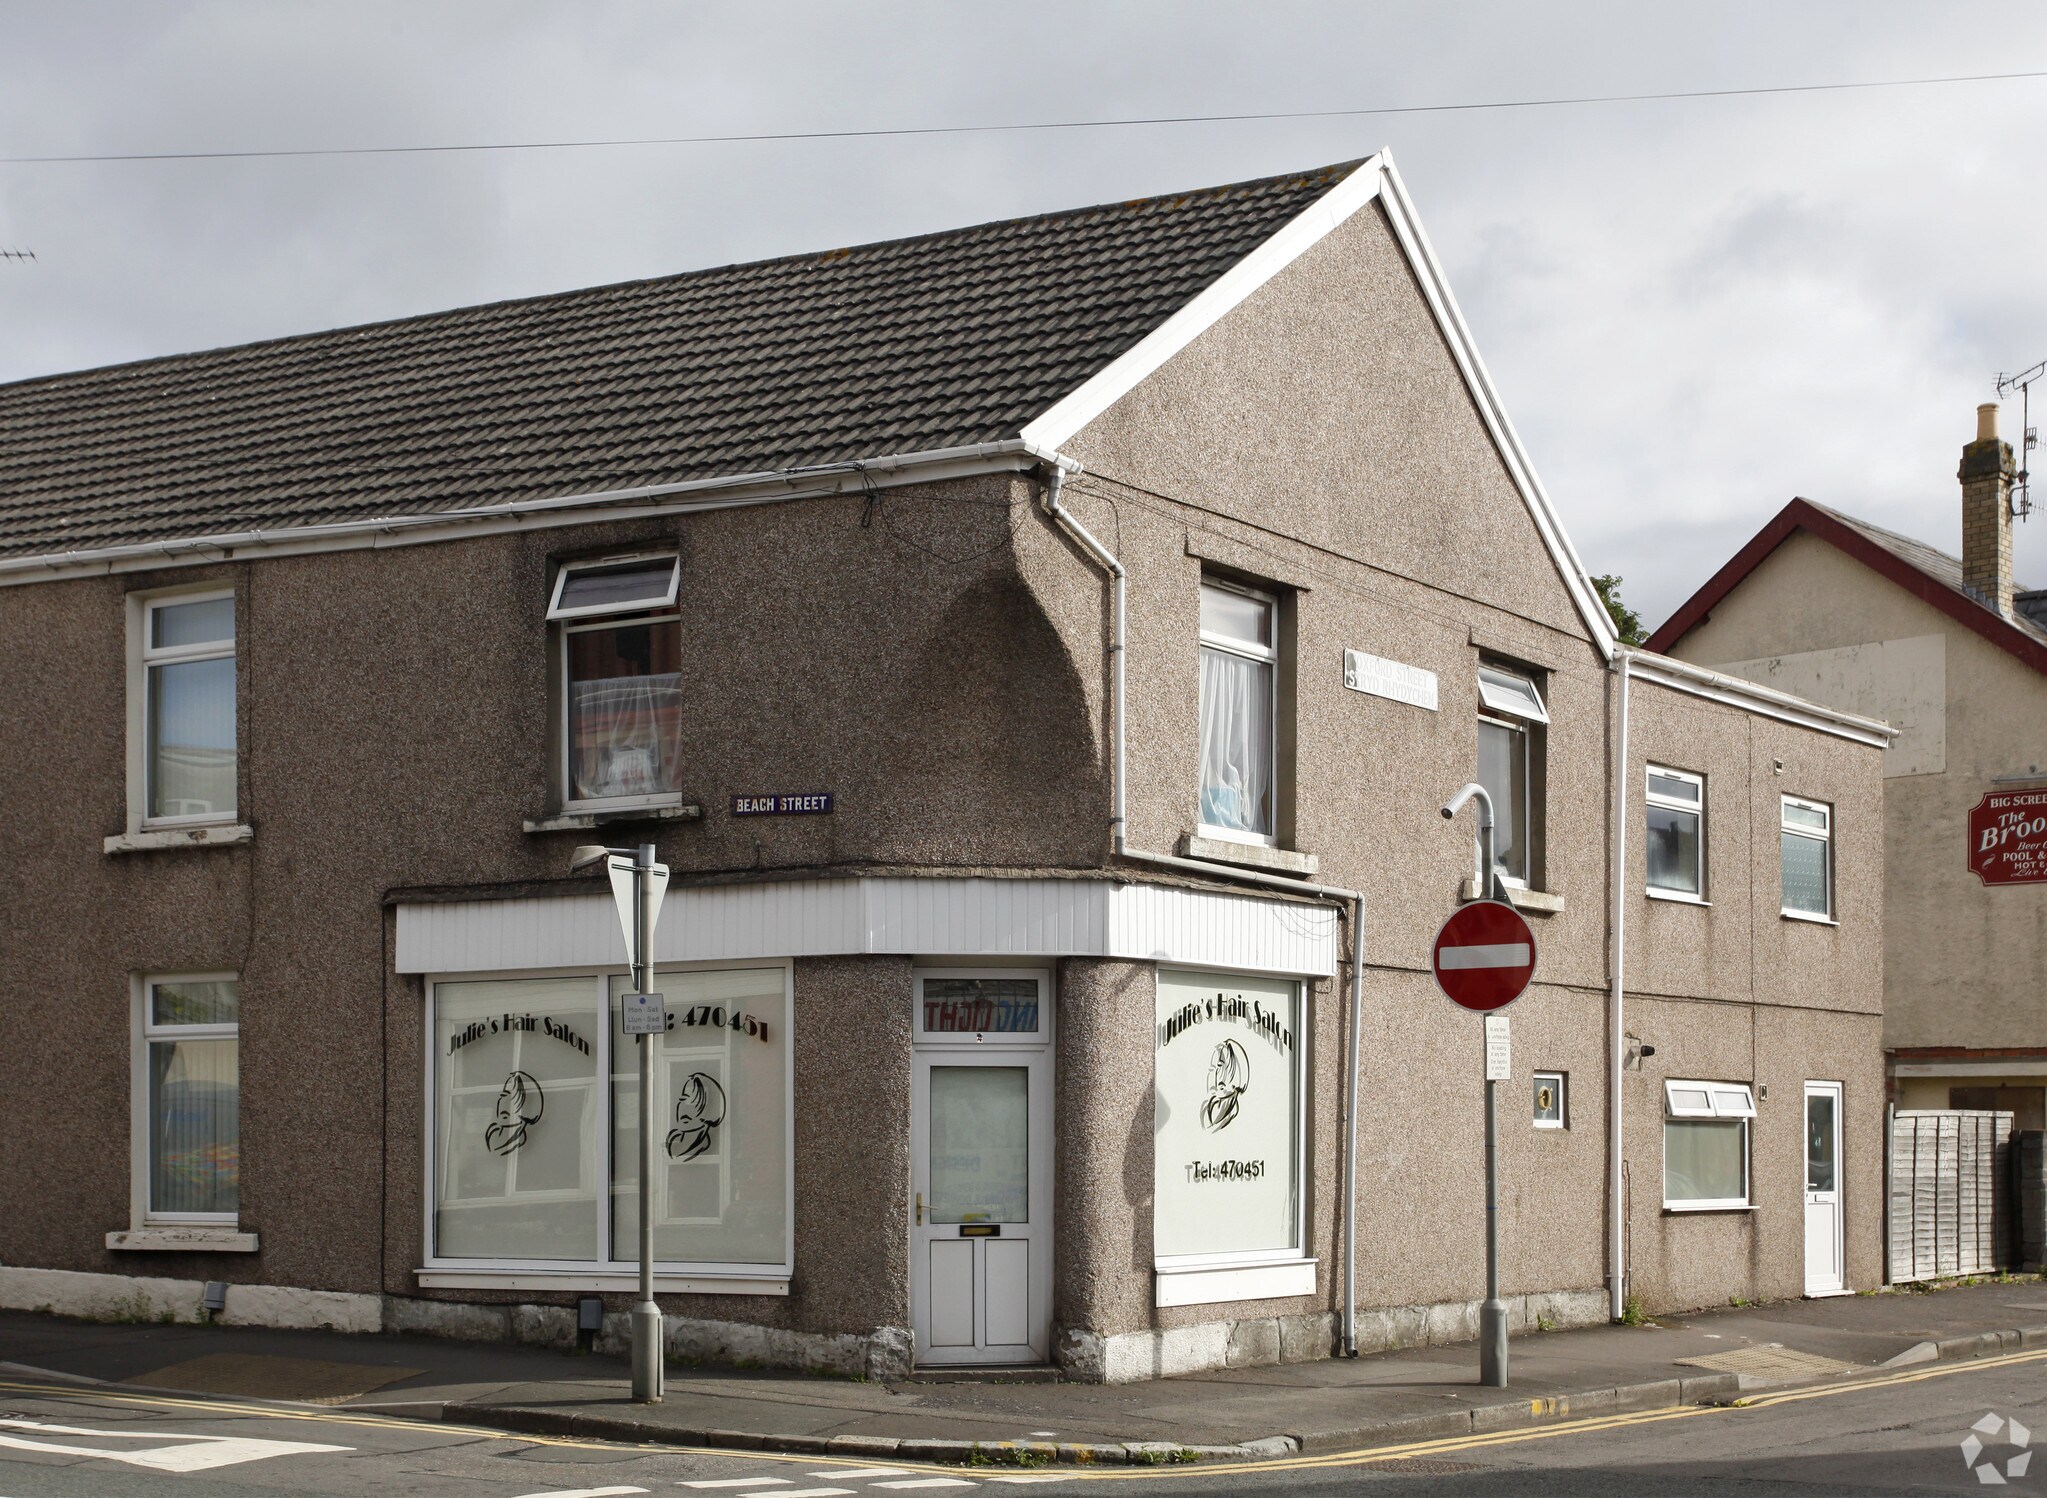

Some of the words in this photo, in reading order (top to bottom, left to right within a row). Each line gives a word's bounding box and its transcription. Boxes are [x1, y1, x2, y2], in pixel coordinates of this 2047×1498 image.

[1356, 653, 1393, 678] OXFORD
[1396, 665, 1429, 689] STREET
[736, 797, 775, 812] BEACH
[780, 796, 827, 811] STREET
[1990, 797, 2011, 808] BIG
[1998, 812, 2025, 827] The
[1979, 817, 2047, 852] Broo
[2017, 841, 2041, 851] Beer
[2002, 851, 2034, 862] POOL
[2014, 861, 2037, 870] HOT
[681, 1005, 768, 1043] 470451
[1160, 997, 1214, 1047] Julie's
[1216, 992, 1250, 1019] Hair
[1253, 1000, 1293, 1052] Salon
[446, 1016, 499, 1056] Julie's
[503, 1012, 539, 1032] Hair
[543, 1016, 590, 1057] Salon
[1220, 1159, 1265, 1178] 470451
